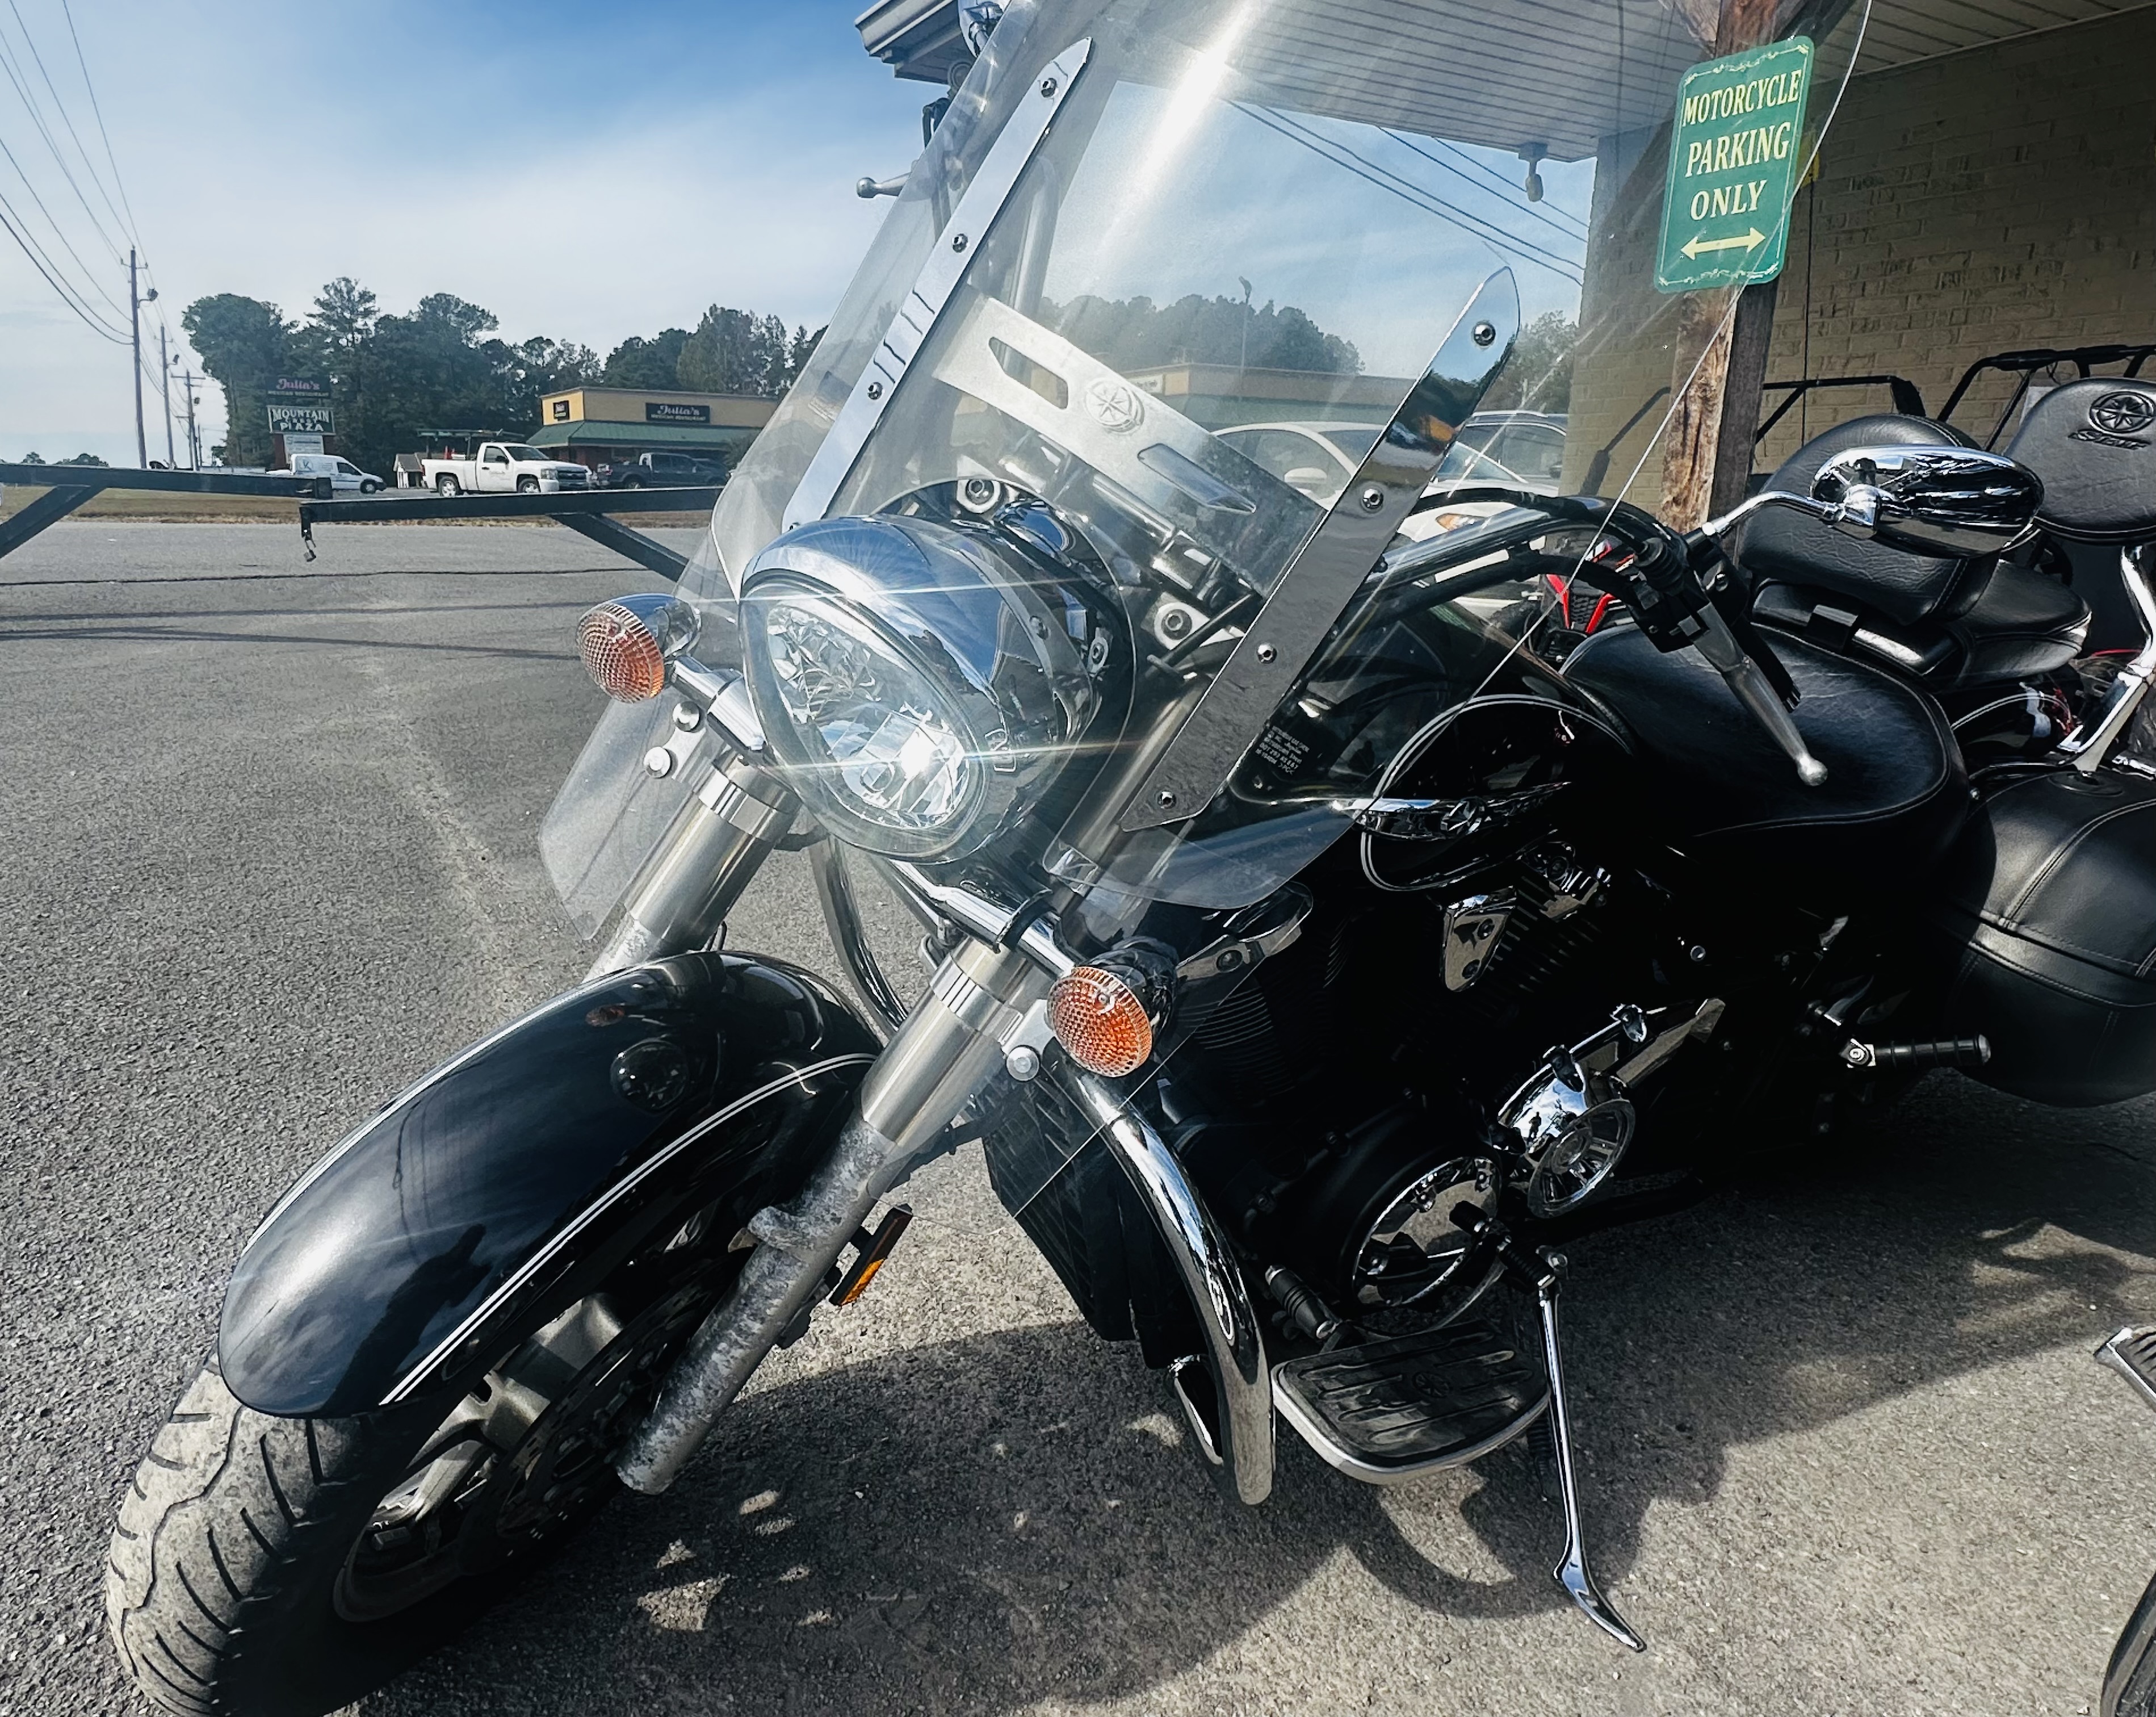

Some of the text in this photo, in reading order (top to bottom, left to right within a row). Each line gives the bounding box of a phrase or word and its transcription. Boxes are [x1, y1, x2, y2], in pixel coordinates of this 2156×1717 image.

[1682, 68, 1802, 127] MOTORCYCLE
[1684, 121, 1792, 178] PARKING
[1689, 179, 1768, 221] ONLY
[276, 378, 320, 391] Julia's
[272, 408, 329, 423] MOUNTAIN
[657, 405, 701, 416] Julia's
[280, 422, 324, 432] PLAZA
